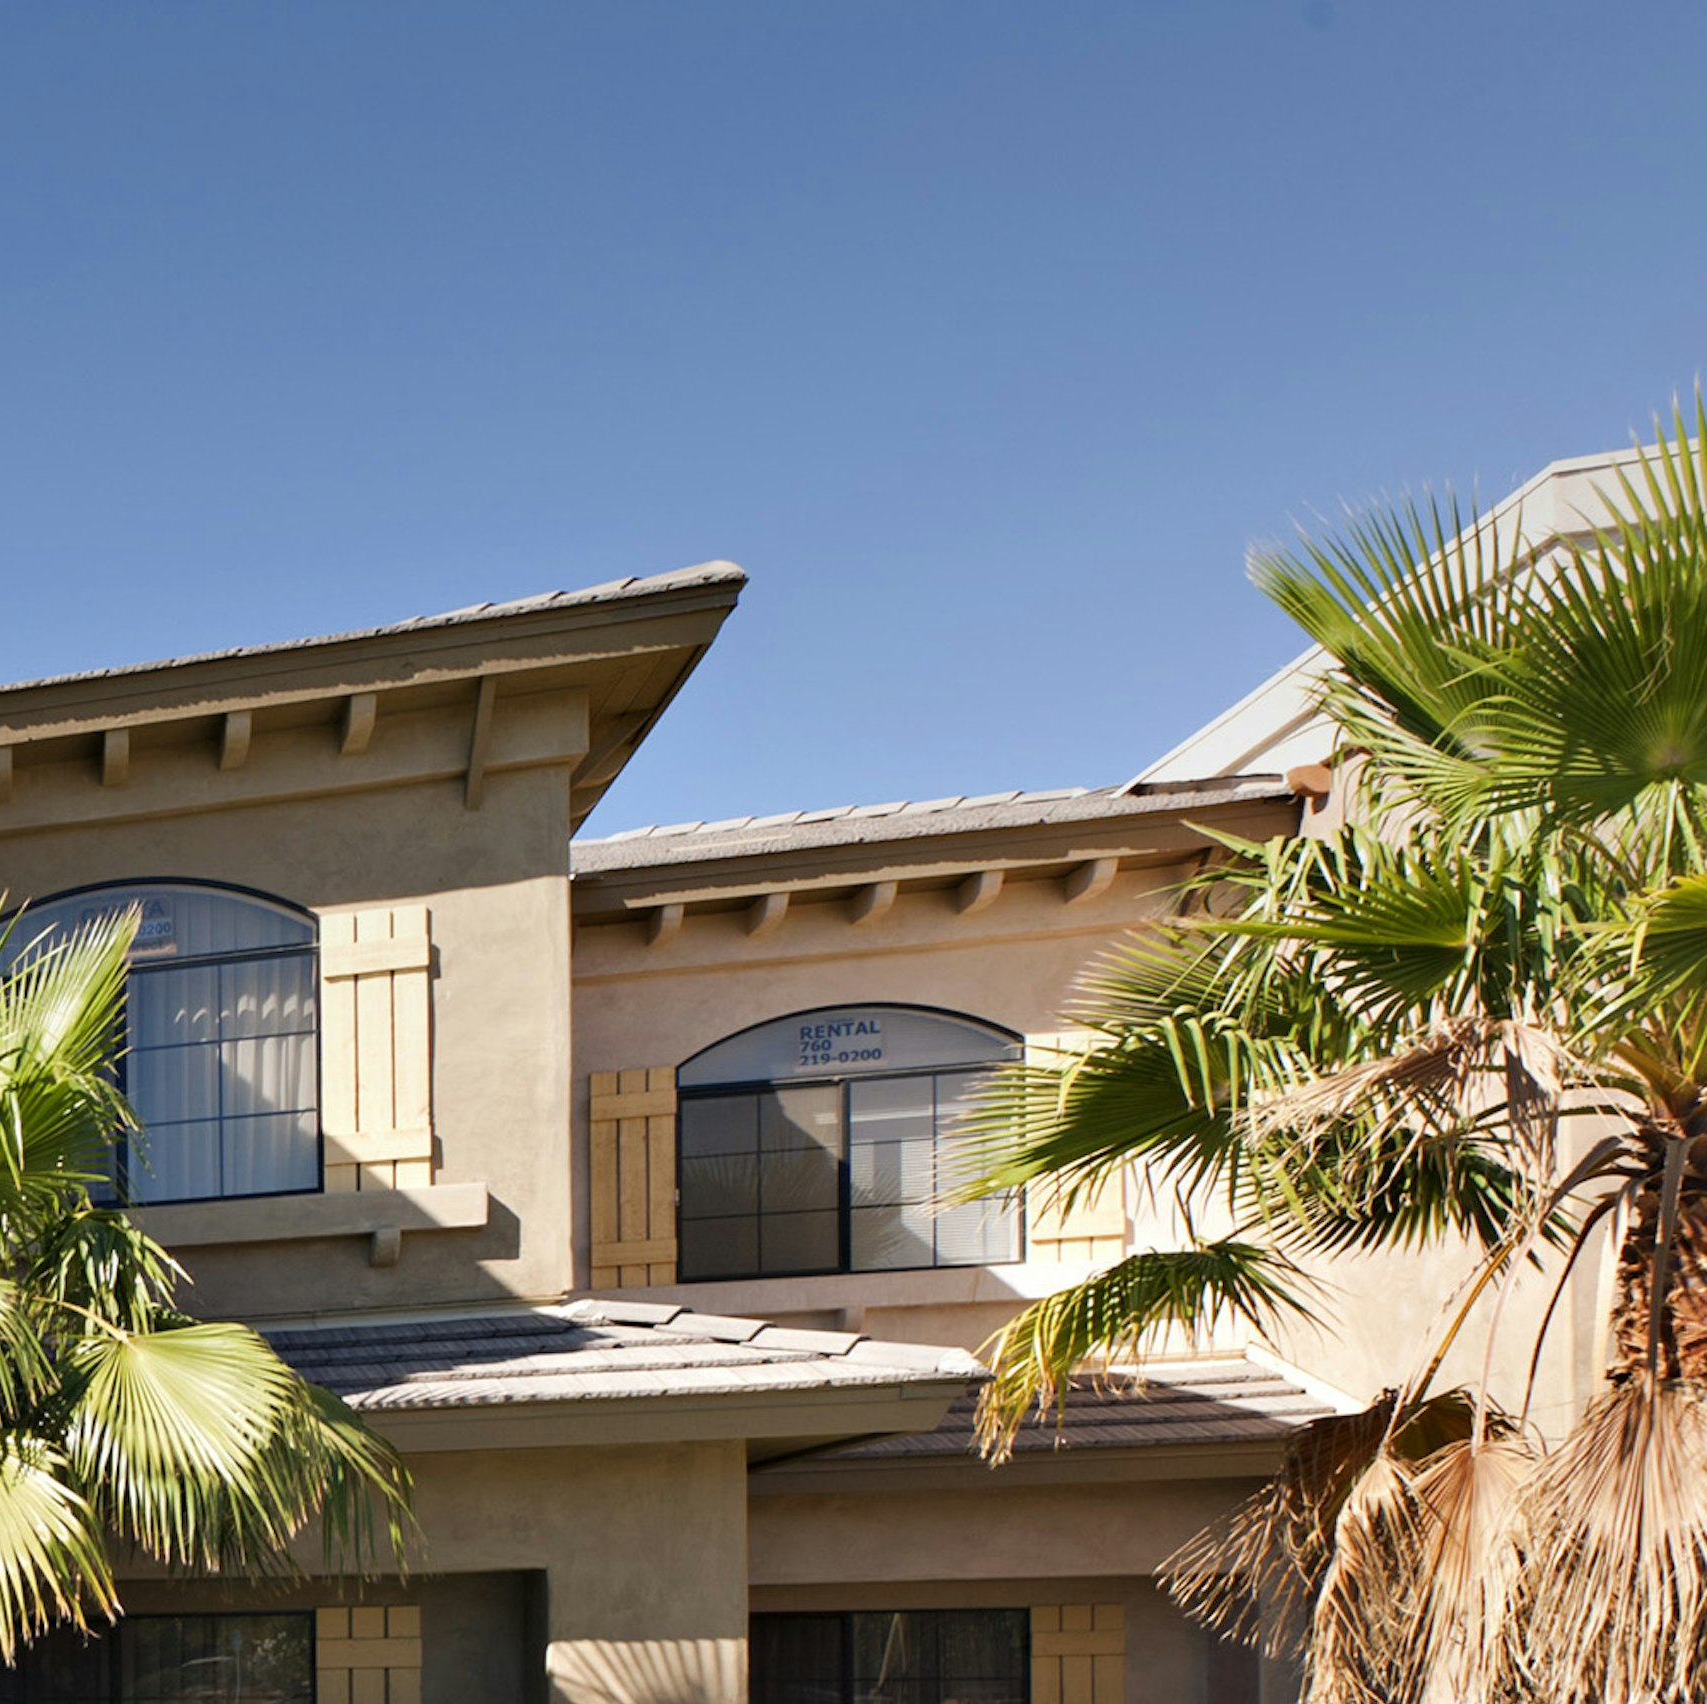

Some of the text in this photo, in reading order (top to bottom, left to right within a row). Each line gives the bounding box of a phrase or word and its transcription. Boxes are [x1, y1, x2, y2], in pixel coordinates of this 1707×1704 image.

[800, 1021, 881, 1040] RENTAL
[800, 1039, 832, 1053] 760
[799, 1048, 882, 1066] 219-0200
